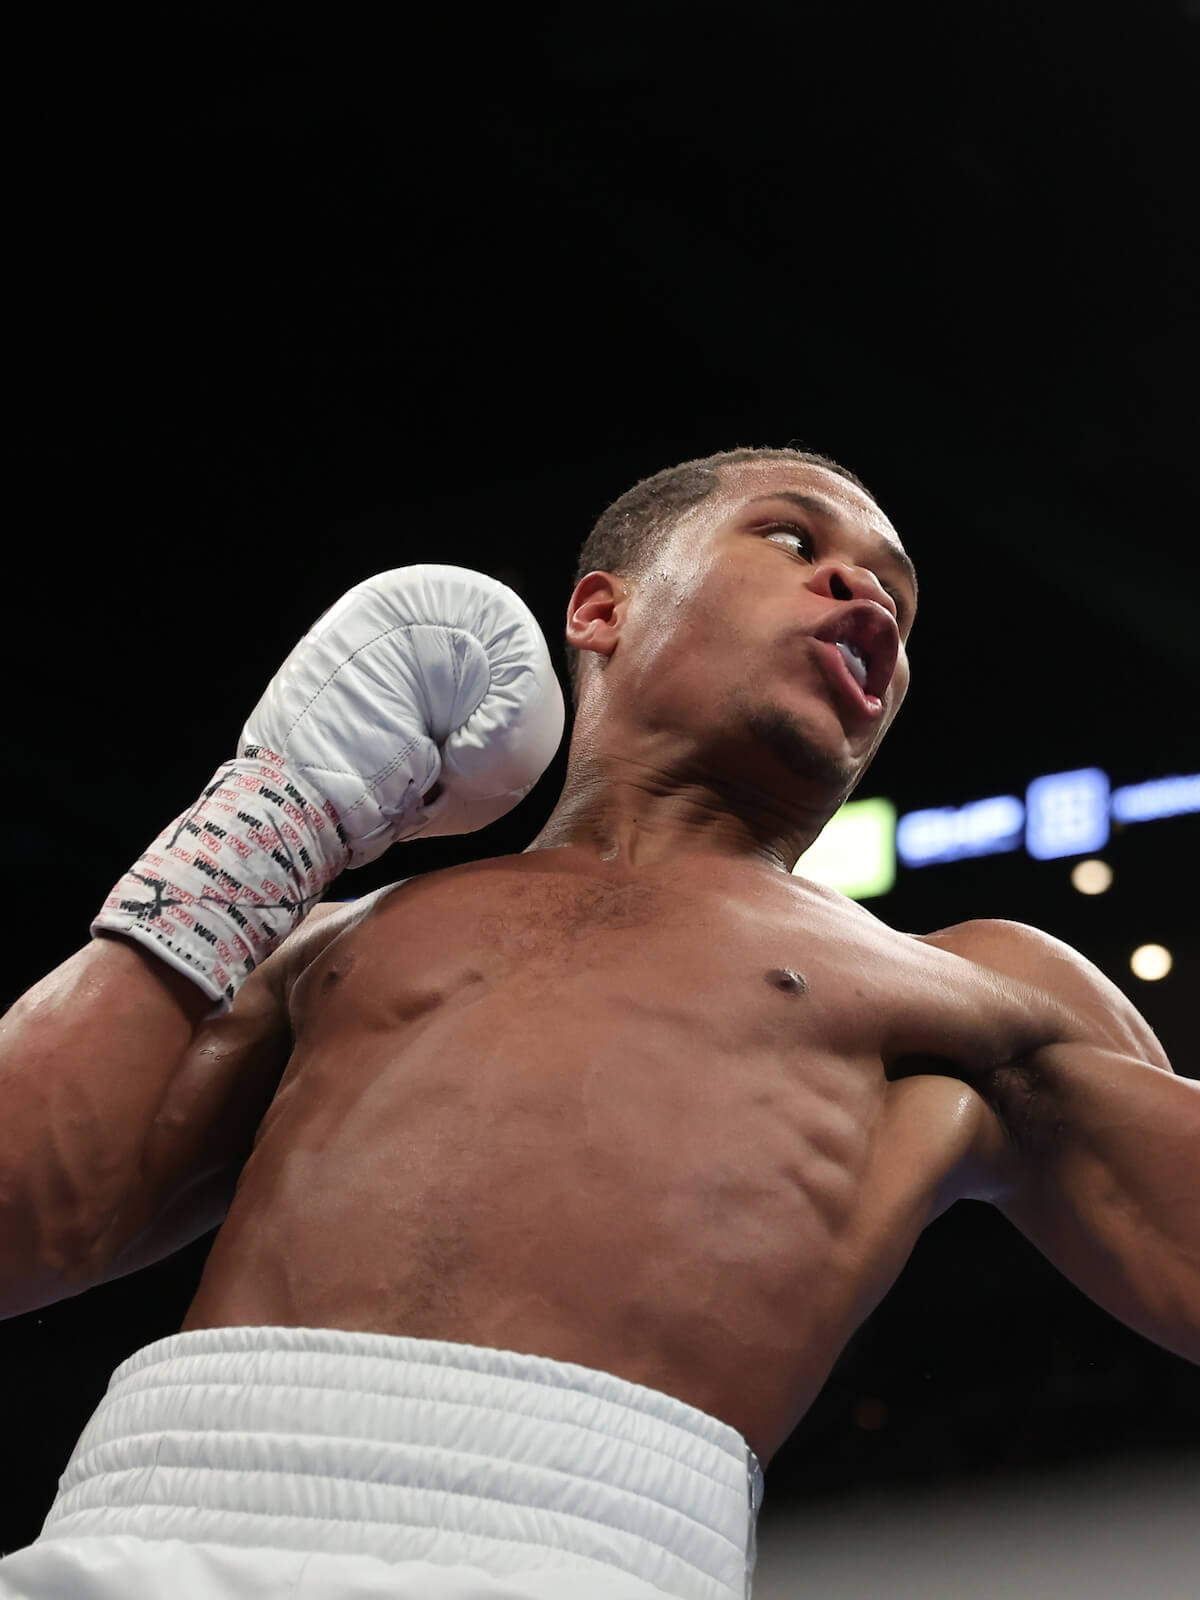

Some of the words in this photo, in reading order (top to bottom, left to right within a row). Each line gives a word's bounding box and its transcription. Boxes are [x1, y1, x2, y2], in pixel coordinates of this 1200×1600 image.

[259, 786, 285, 807] WAR
[285, 783, 308, 808] WAR
[204, 821, 226, 839] WAR
[238, 811, 262, 829] WAR
[194, 858, 220, 878] WAR
[271, 849, 294, 872] WAR
[298, 846, 313, 870] WAR
[227, 903, 248, 928] WAR
[194, 923, 217, 945] WAR
